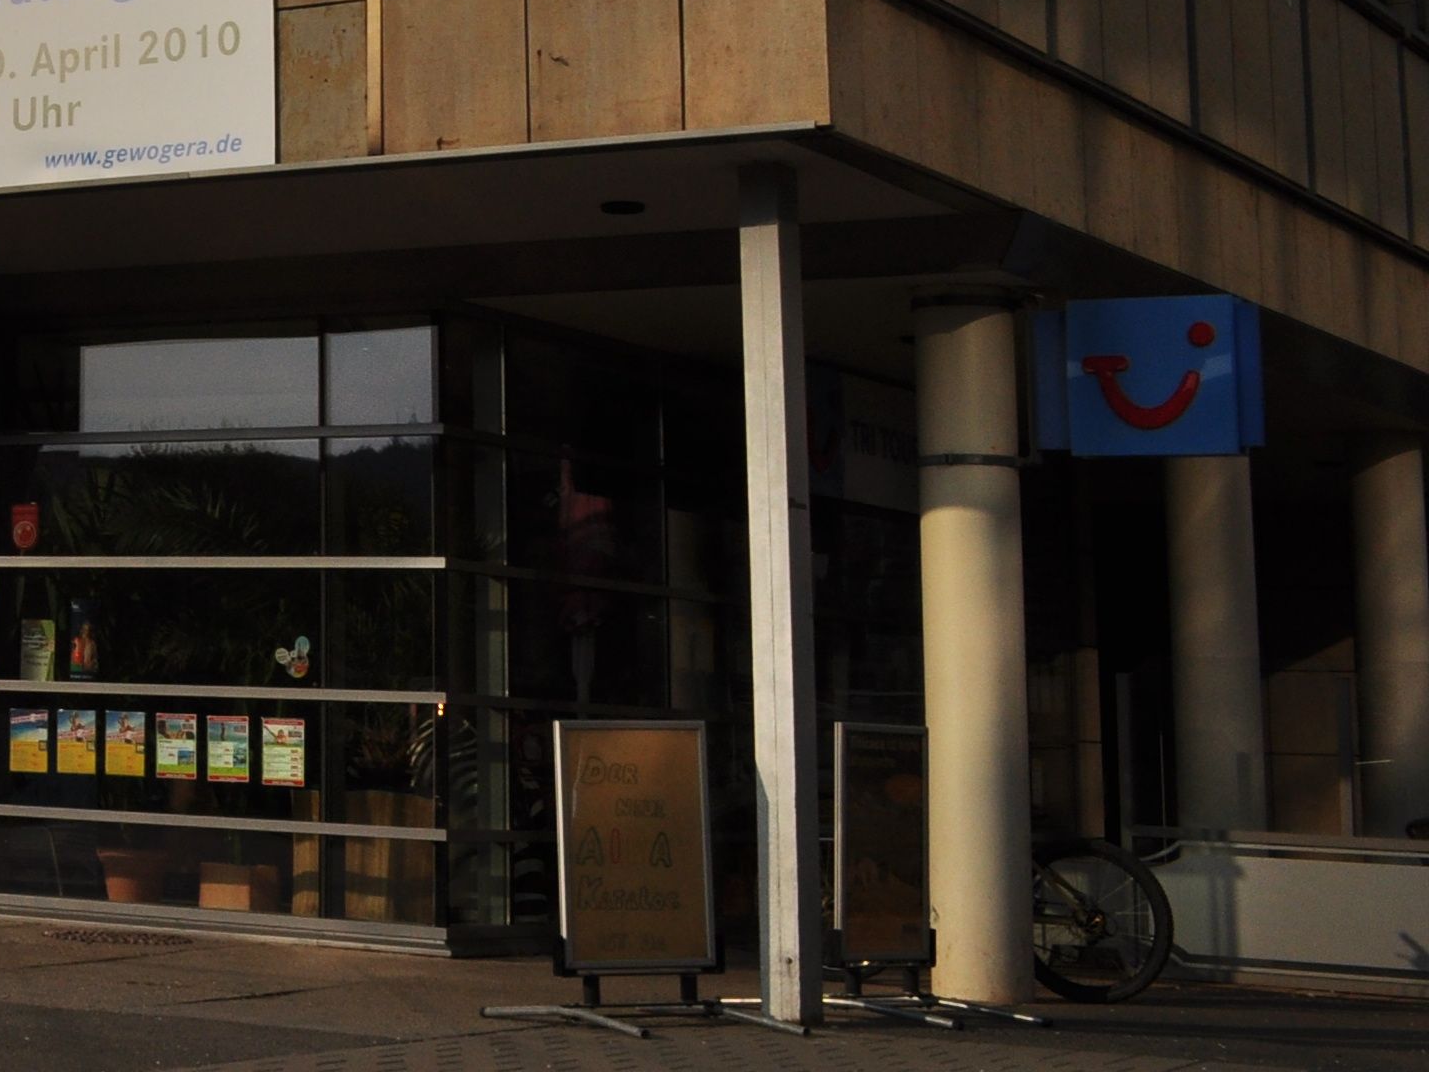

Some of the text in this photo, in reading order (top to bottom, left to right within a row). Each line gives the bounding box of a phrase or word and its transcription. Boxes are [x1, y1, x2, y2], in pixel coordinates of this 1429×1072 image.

[31, 30, 121, 84] April
[138, 20, 242, 66] 2010
[11, 95, 82, 132] Uhr
[44, 133, 243, 170] www.gewogera.de
